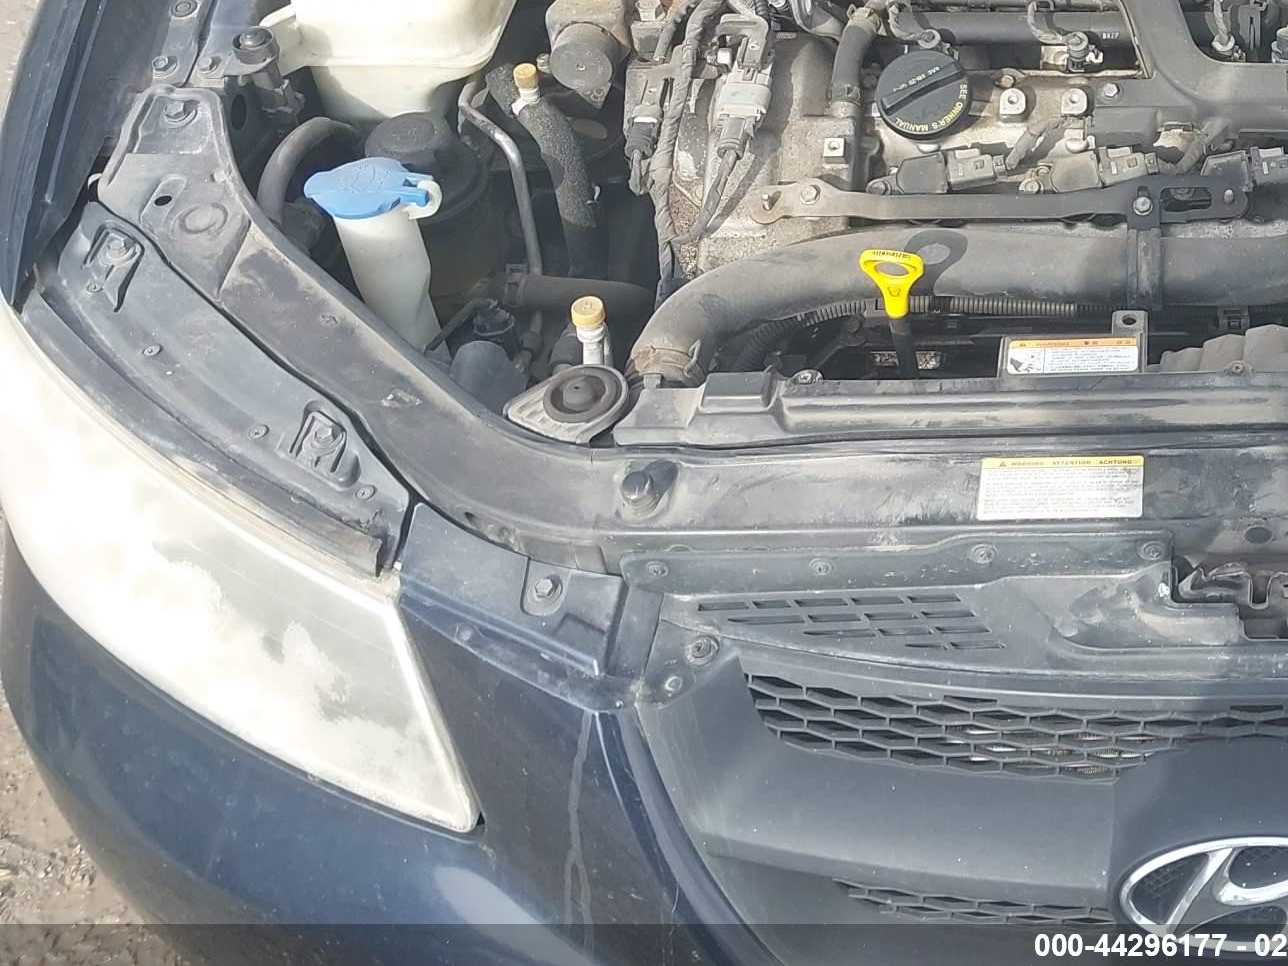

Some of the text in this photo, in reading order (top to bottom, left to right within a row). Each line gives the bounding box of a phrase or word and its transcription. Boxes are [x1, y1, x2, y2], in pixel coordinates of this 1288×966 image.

[895, 84, 968, 132] SEE OWNER'S MANUAL
